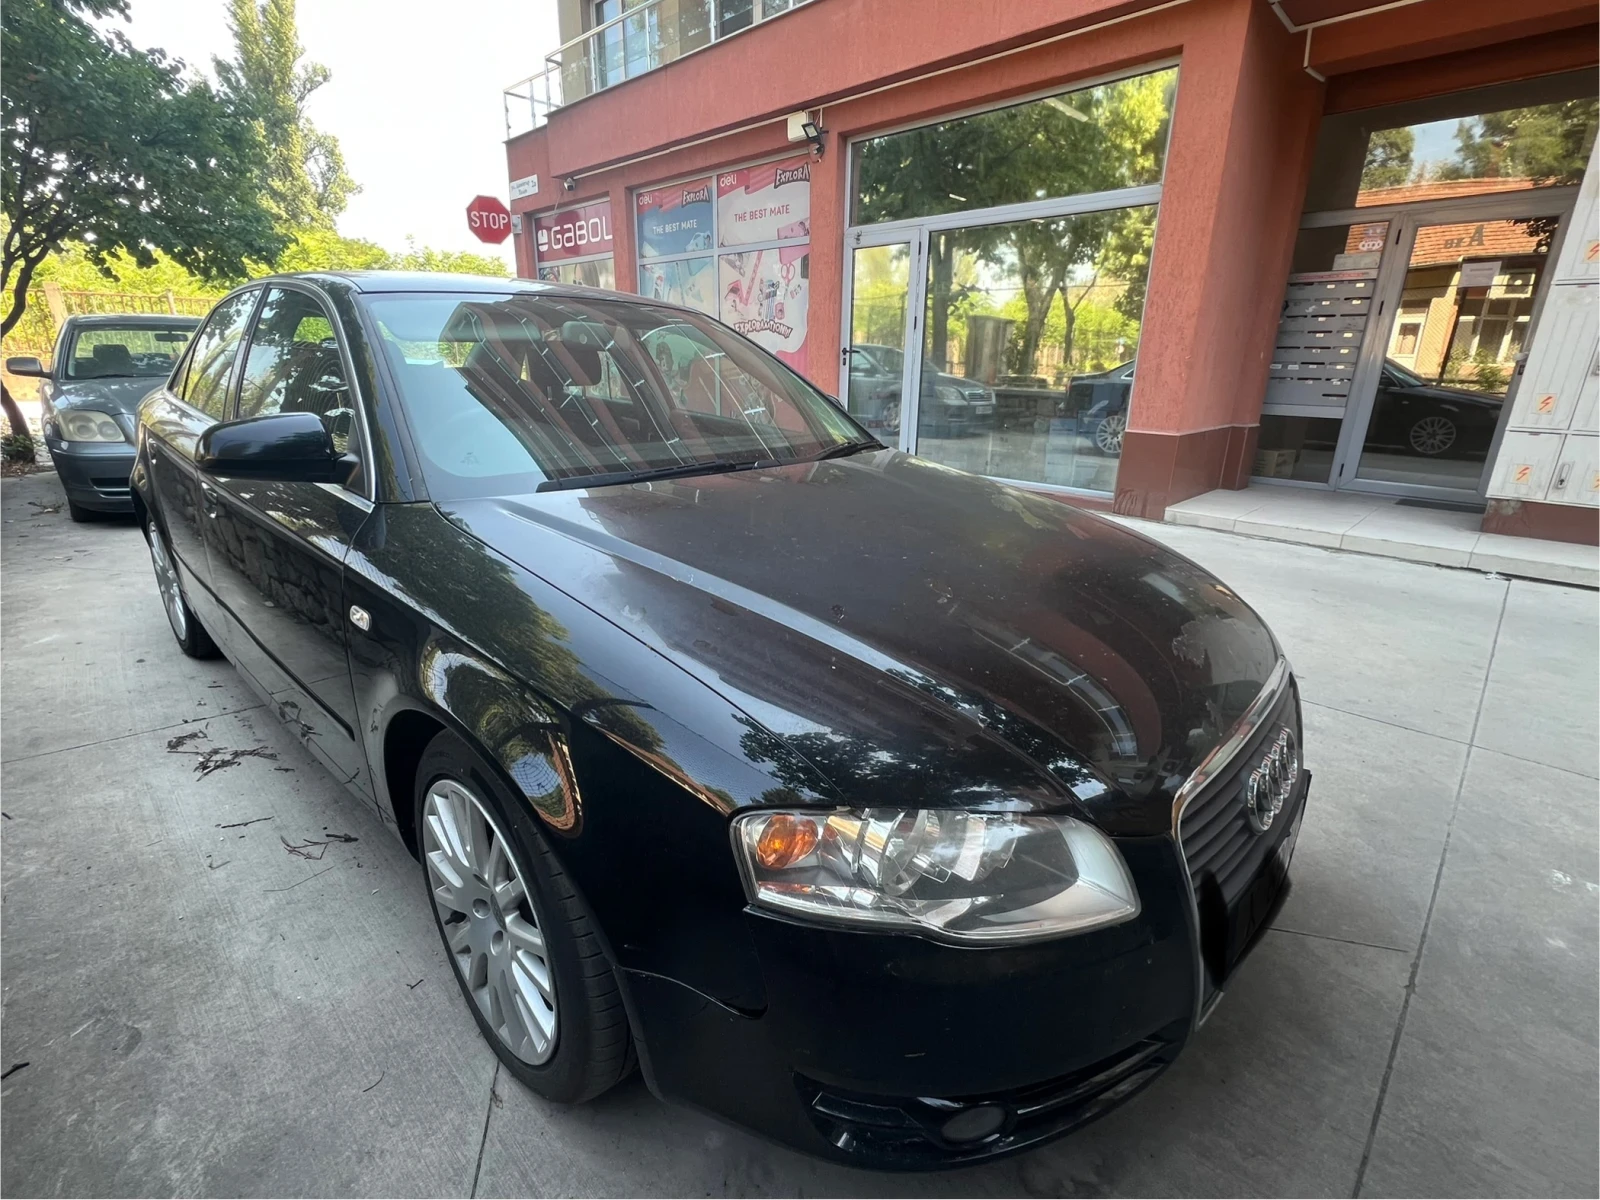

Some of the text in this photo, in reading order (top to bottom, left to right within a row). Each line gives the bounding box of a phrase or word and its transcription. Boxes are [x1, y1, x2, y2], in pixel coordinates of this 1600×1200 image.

[720, 173, 737, 187] deli
[638, 193, 653, 206] deli
[682, 186, 709, 206] EXPLORA
[470, 210, 509, 230] STOP
[734, 204, 790, 222] THE BEST MATE
[652, 219, 697, 235] THE BEST MATE
